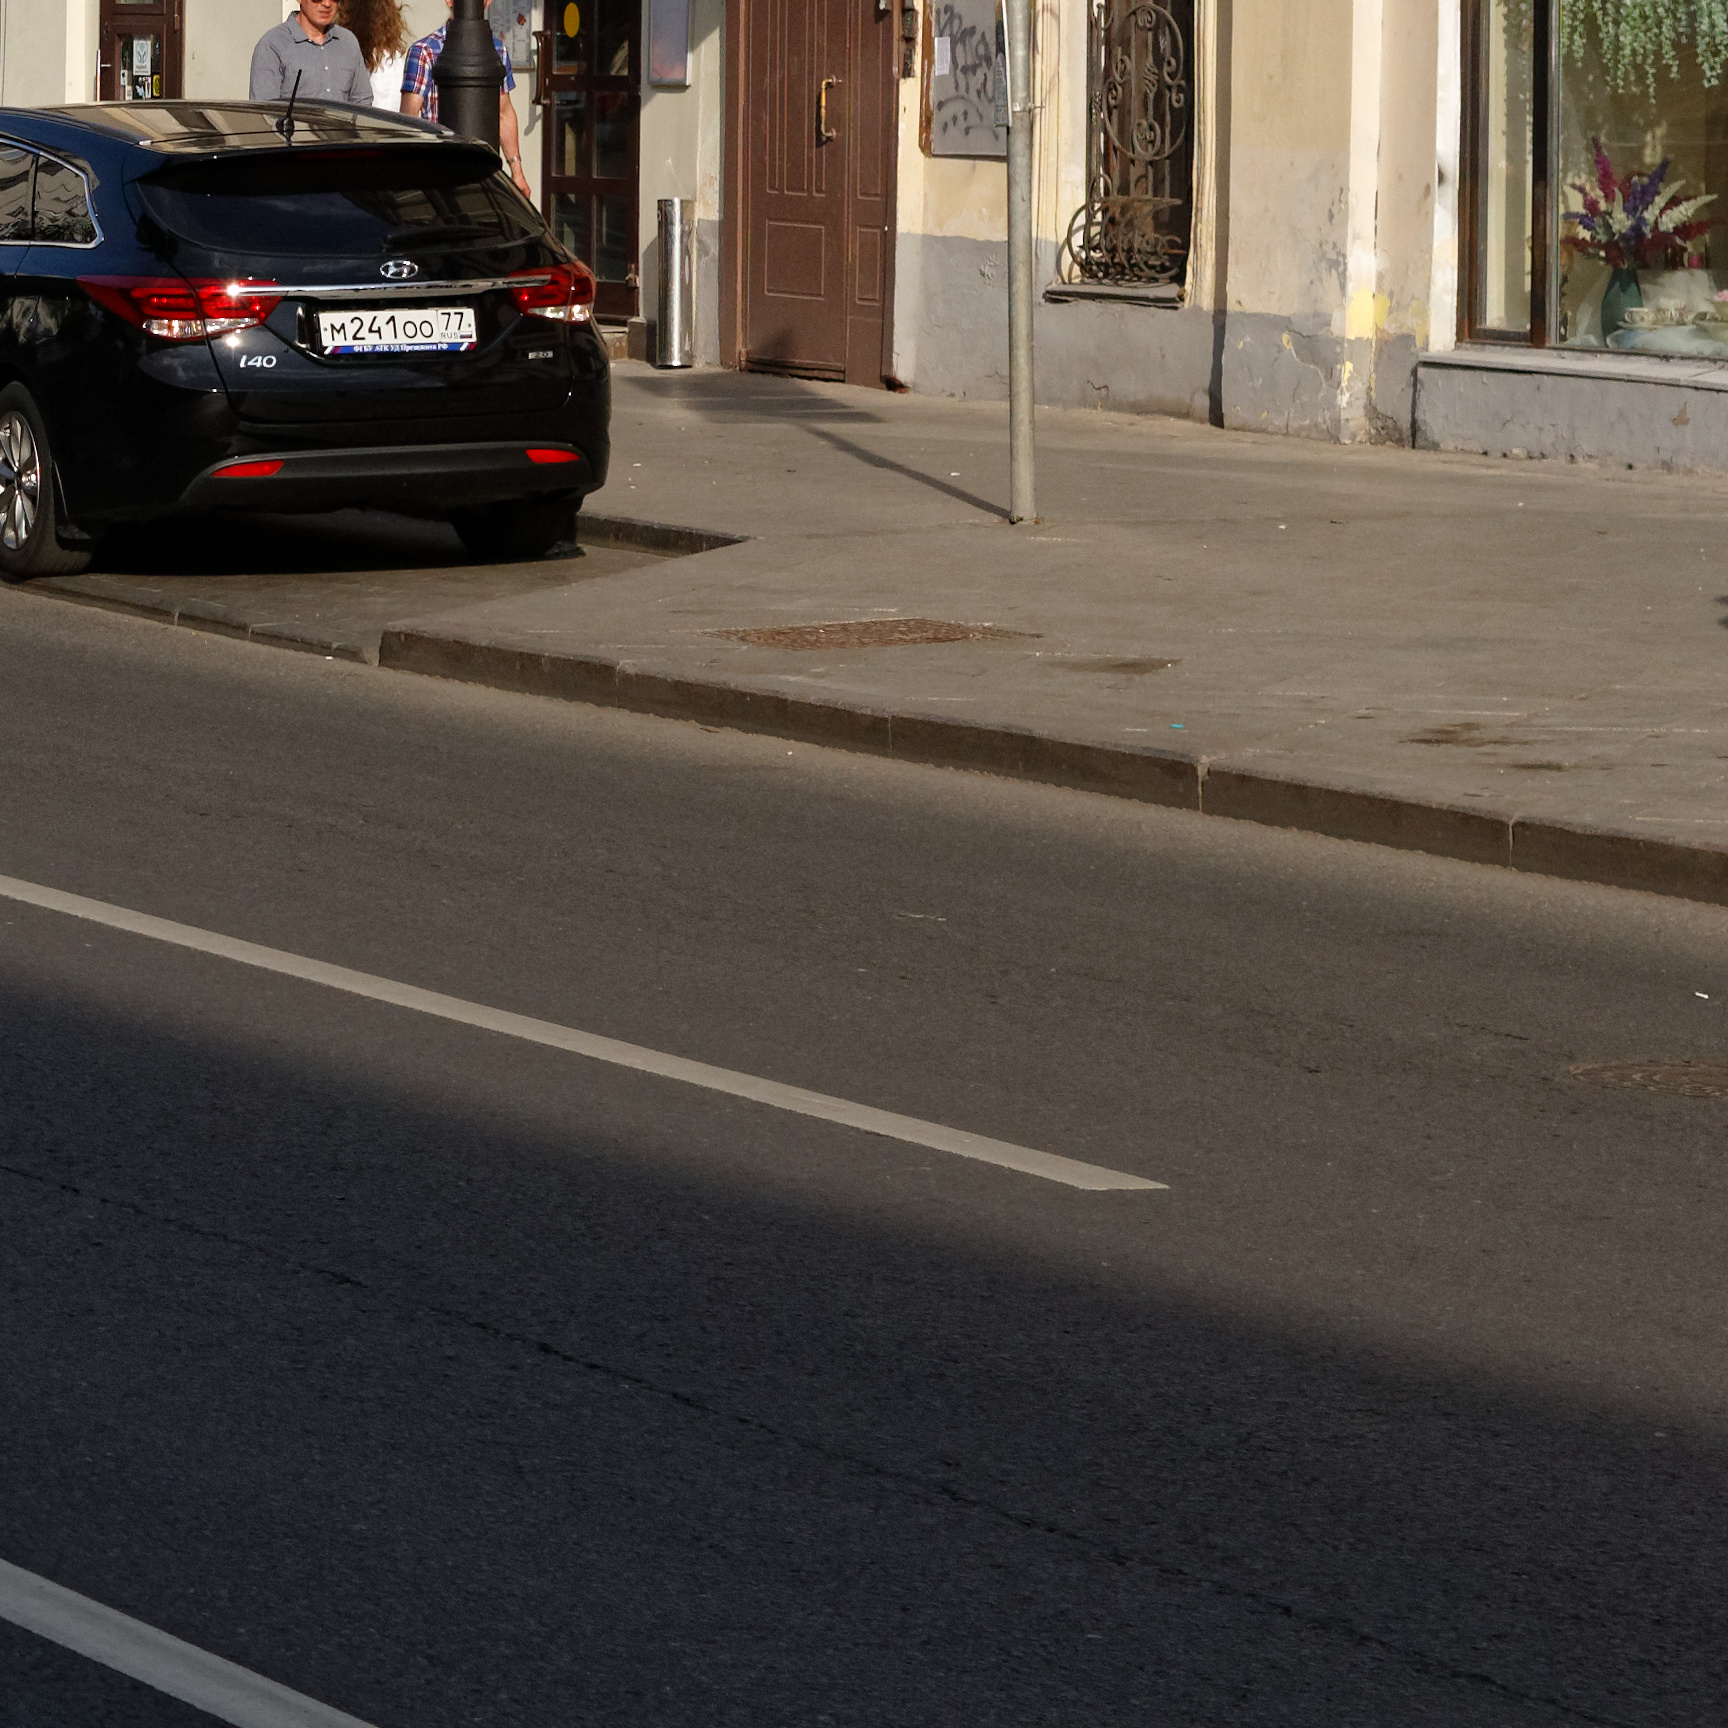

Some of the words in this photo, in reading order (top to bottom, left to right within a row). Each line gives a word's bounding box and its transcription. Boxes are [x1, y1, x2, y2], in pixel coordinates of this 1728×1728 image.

[330, 315, 434, 342] М241ОО
[444, 312, 465, 332] 77
[440, 331, 459, 340] RUS
